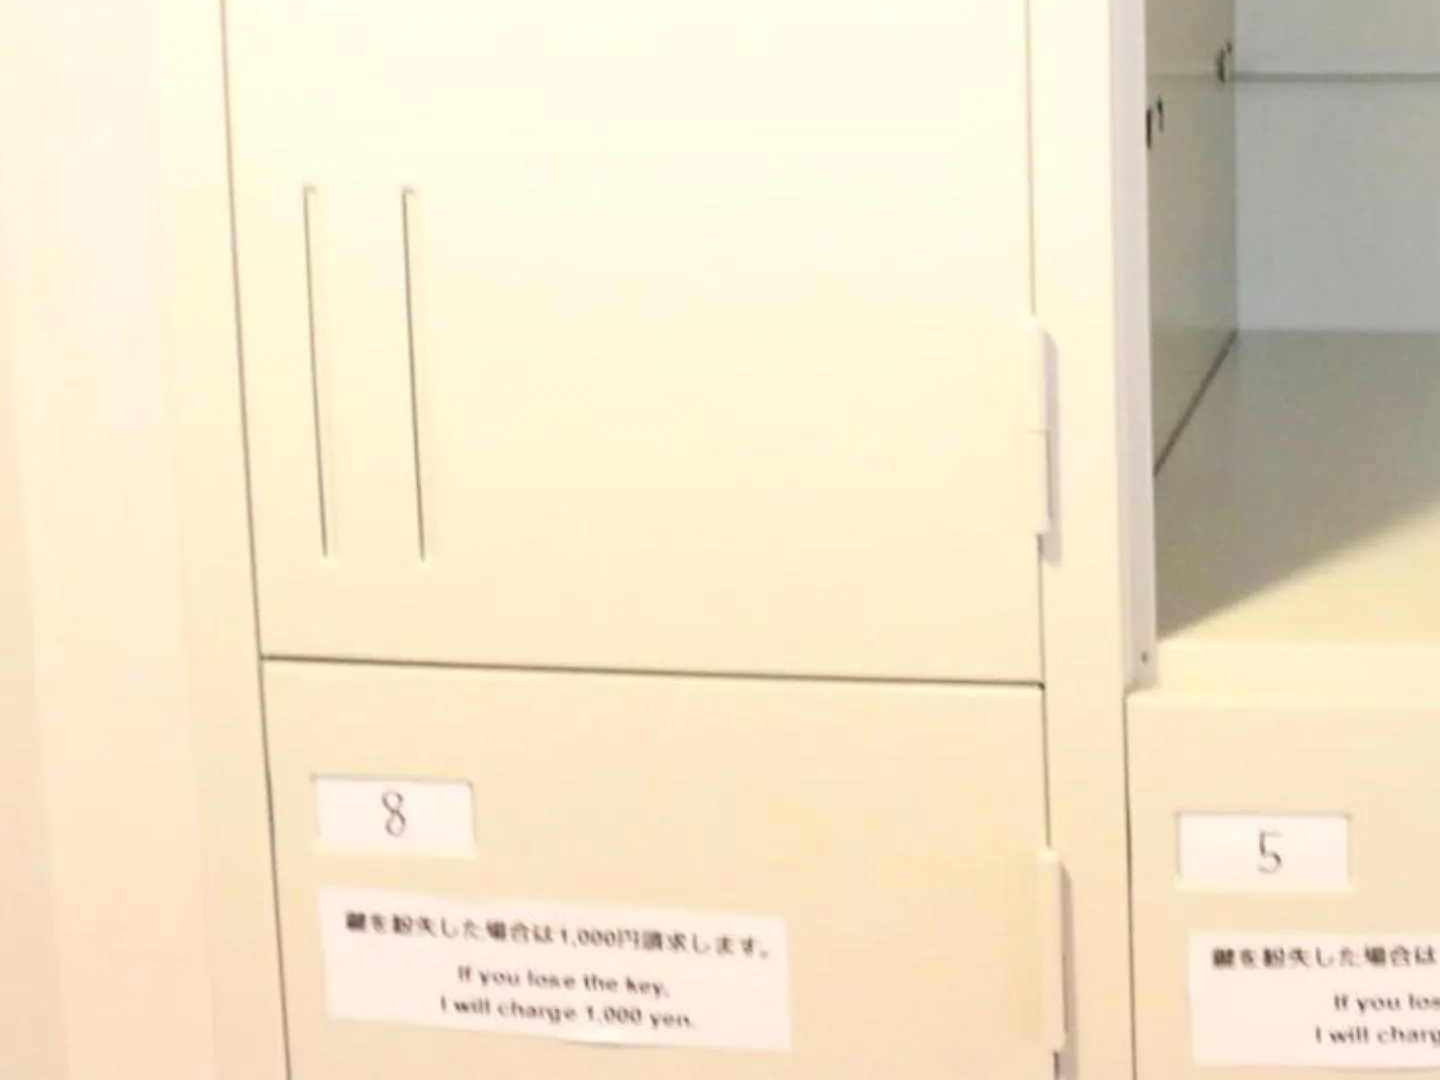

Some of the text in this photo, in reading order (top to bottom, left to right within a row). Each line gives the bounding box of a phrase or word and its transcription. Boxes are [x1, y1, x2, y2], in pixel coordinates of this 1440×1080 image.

[380, 790, 408, 838] 8
[1256, 829, 1283, 875] 5
[457, 964, 473, 983] If
[477, 970, 521, 988] you
[526, 968, 577, 991] lose
[582, 972, 619, 993] the
[452, 997, 492, 1016] will
[496, 999, 578, 1025] charge
[585, 1004, 644, 1026] 1,000
[1333, 992, 1350, 1012] If
[1355, 996, 1402, 1015] you
[1328, 1025, 1370, 1045] will
